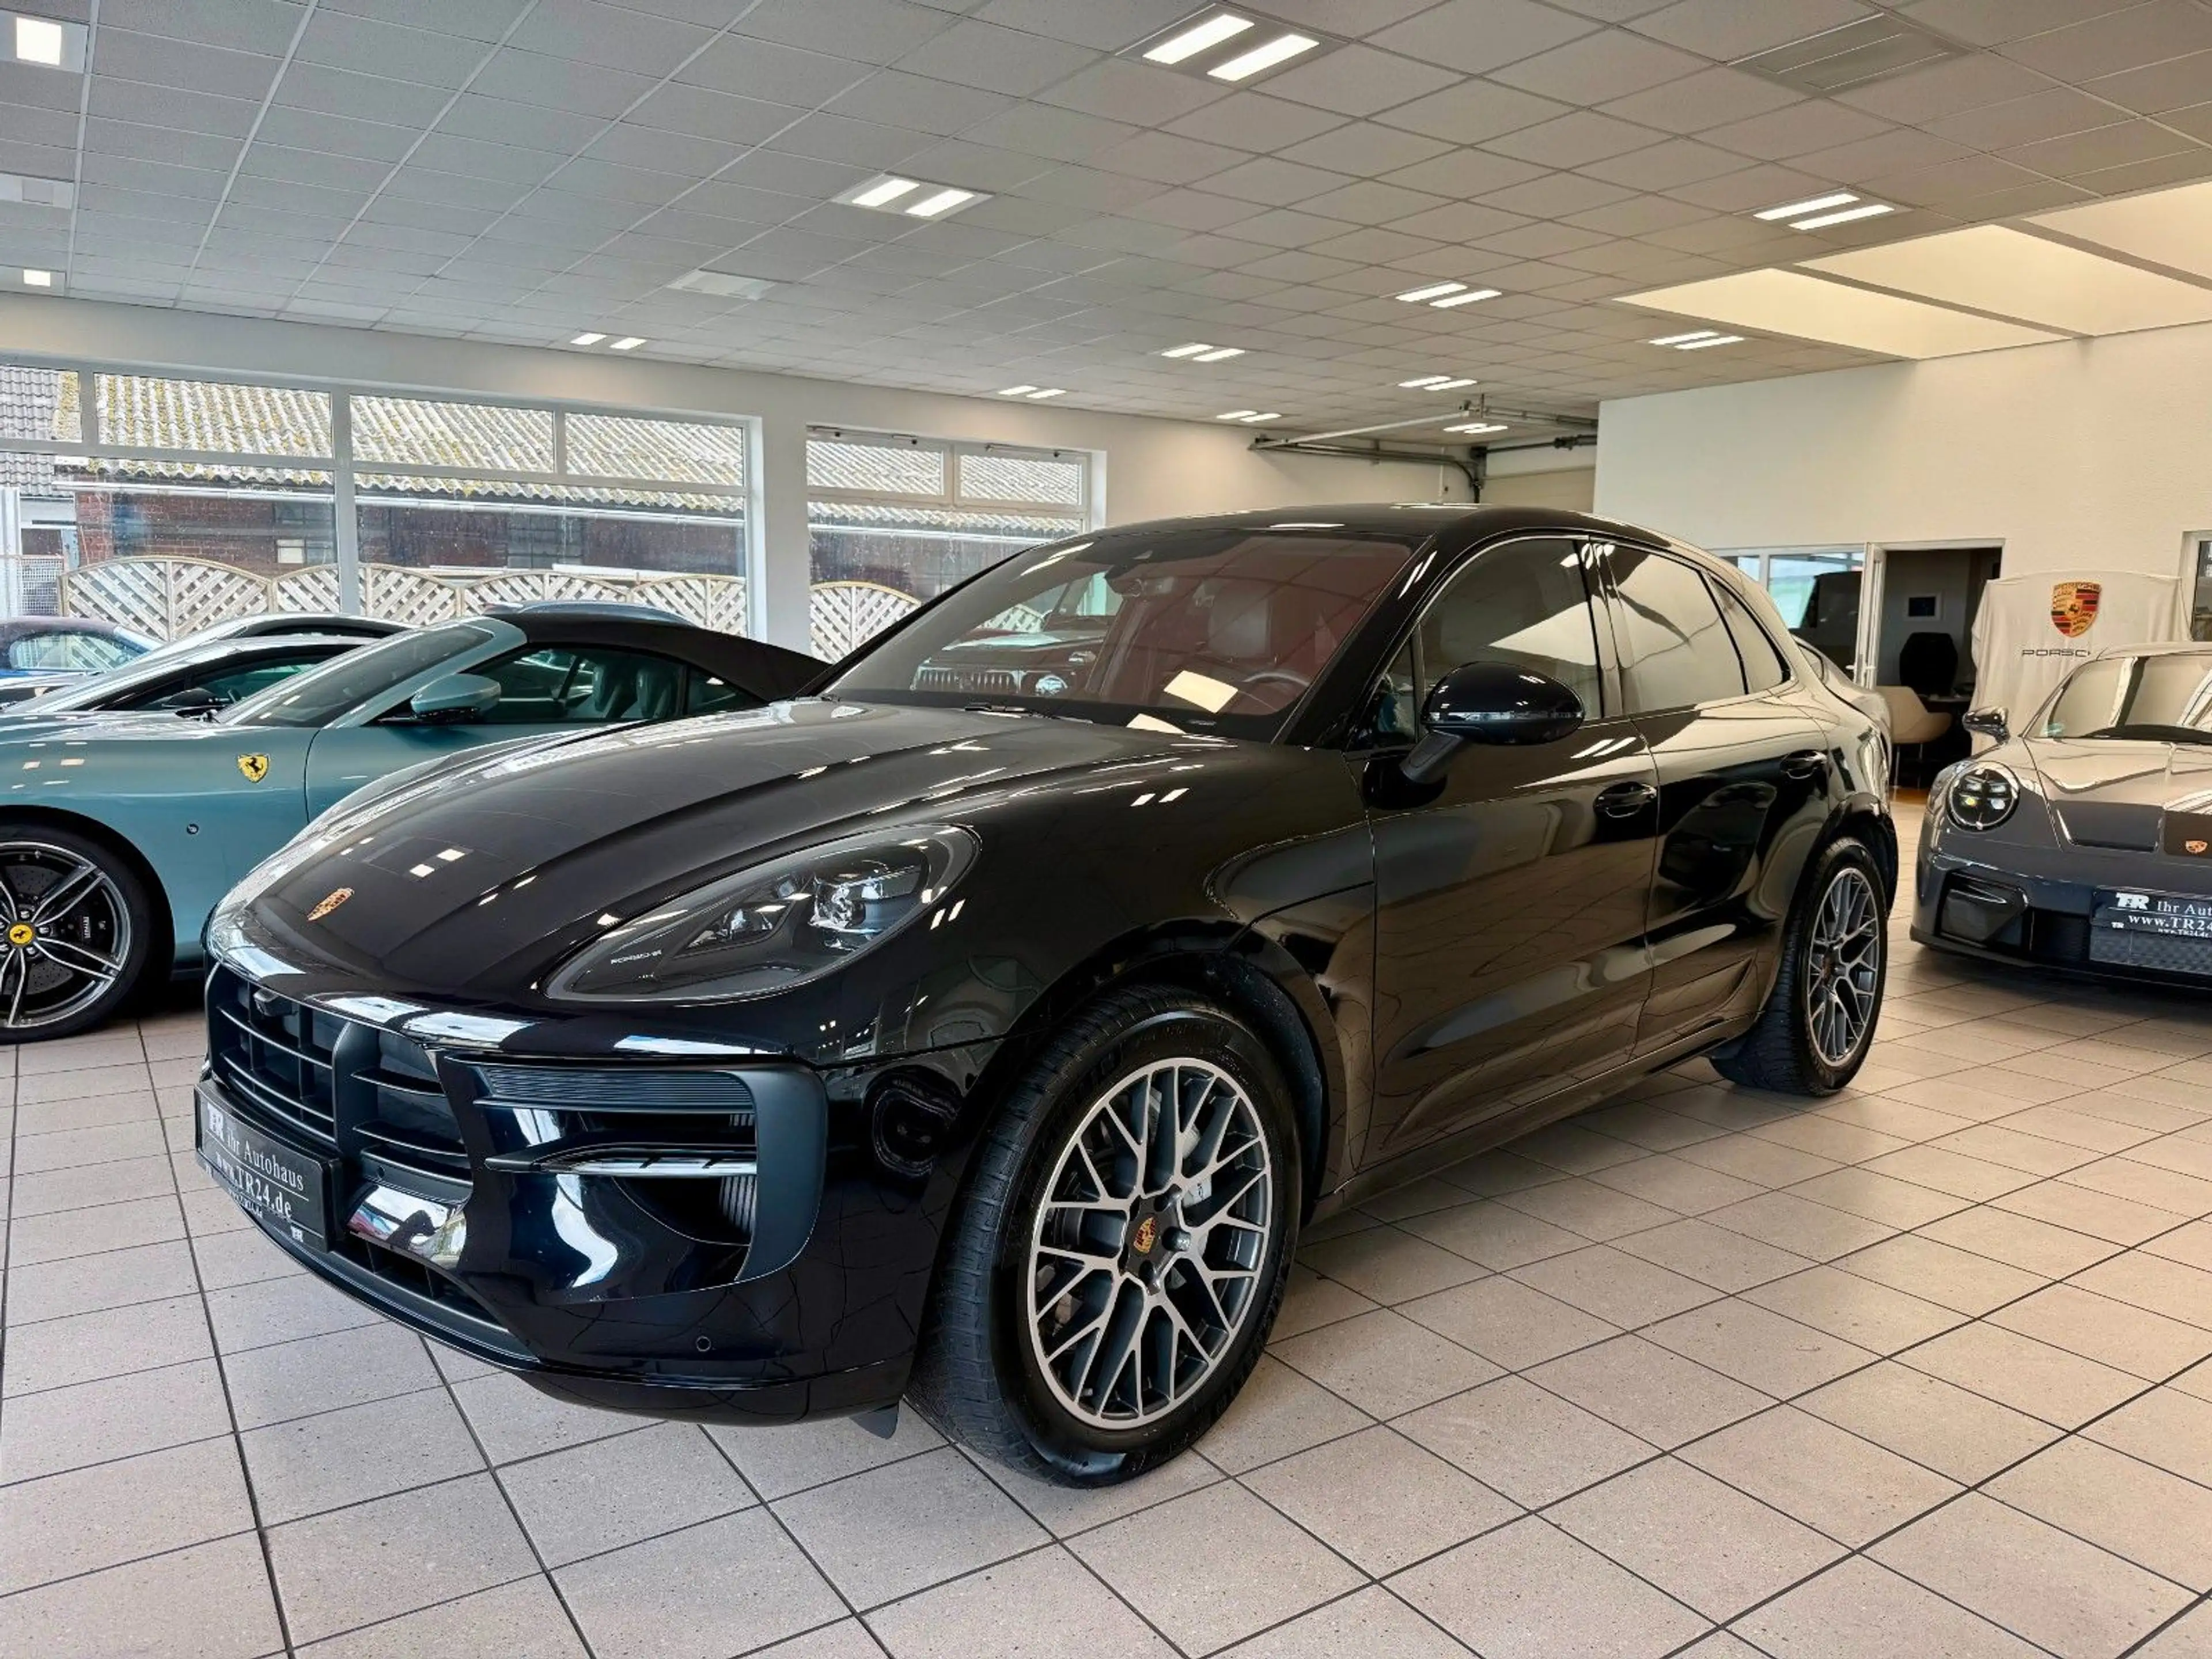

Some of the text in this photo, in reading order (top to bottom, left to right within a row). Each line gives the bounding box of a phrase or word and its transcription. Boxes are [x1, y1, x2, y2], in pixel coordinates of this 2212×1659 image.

[2116, 892, 2212, 916] TR Ihr Aut
[2128, 915, 2212, 931] www.TR24
[244, 1140, 304, 1191] Autohaus
